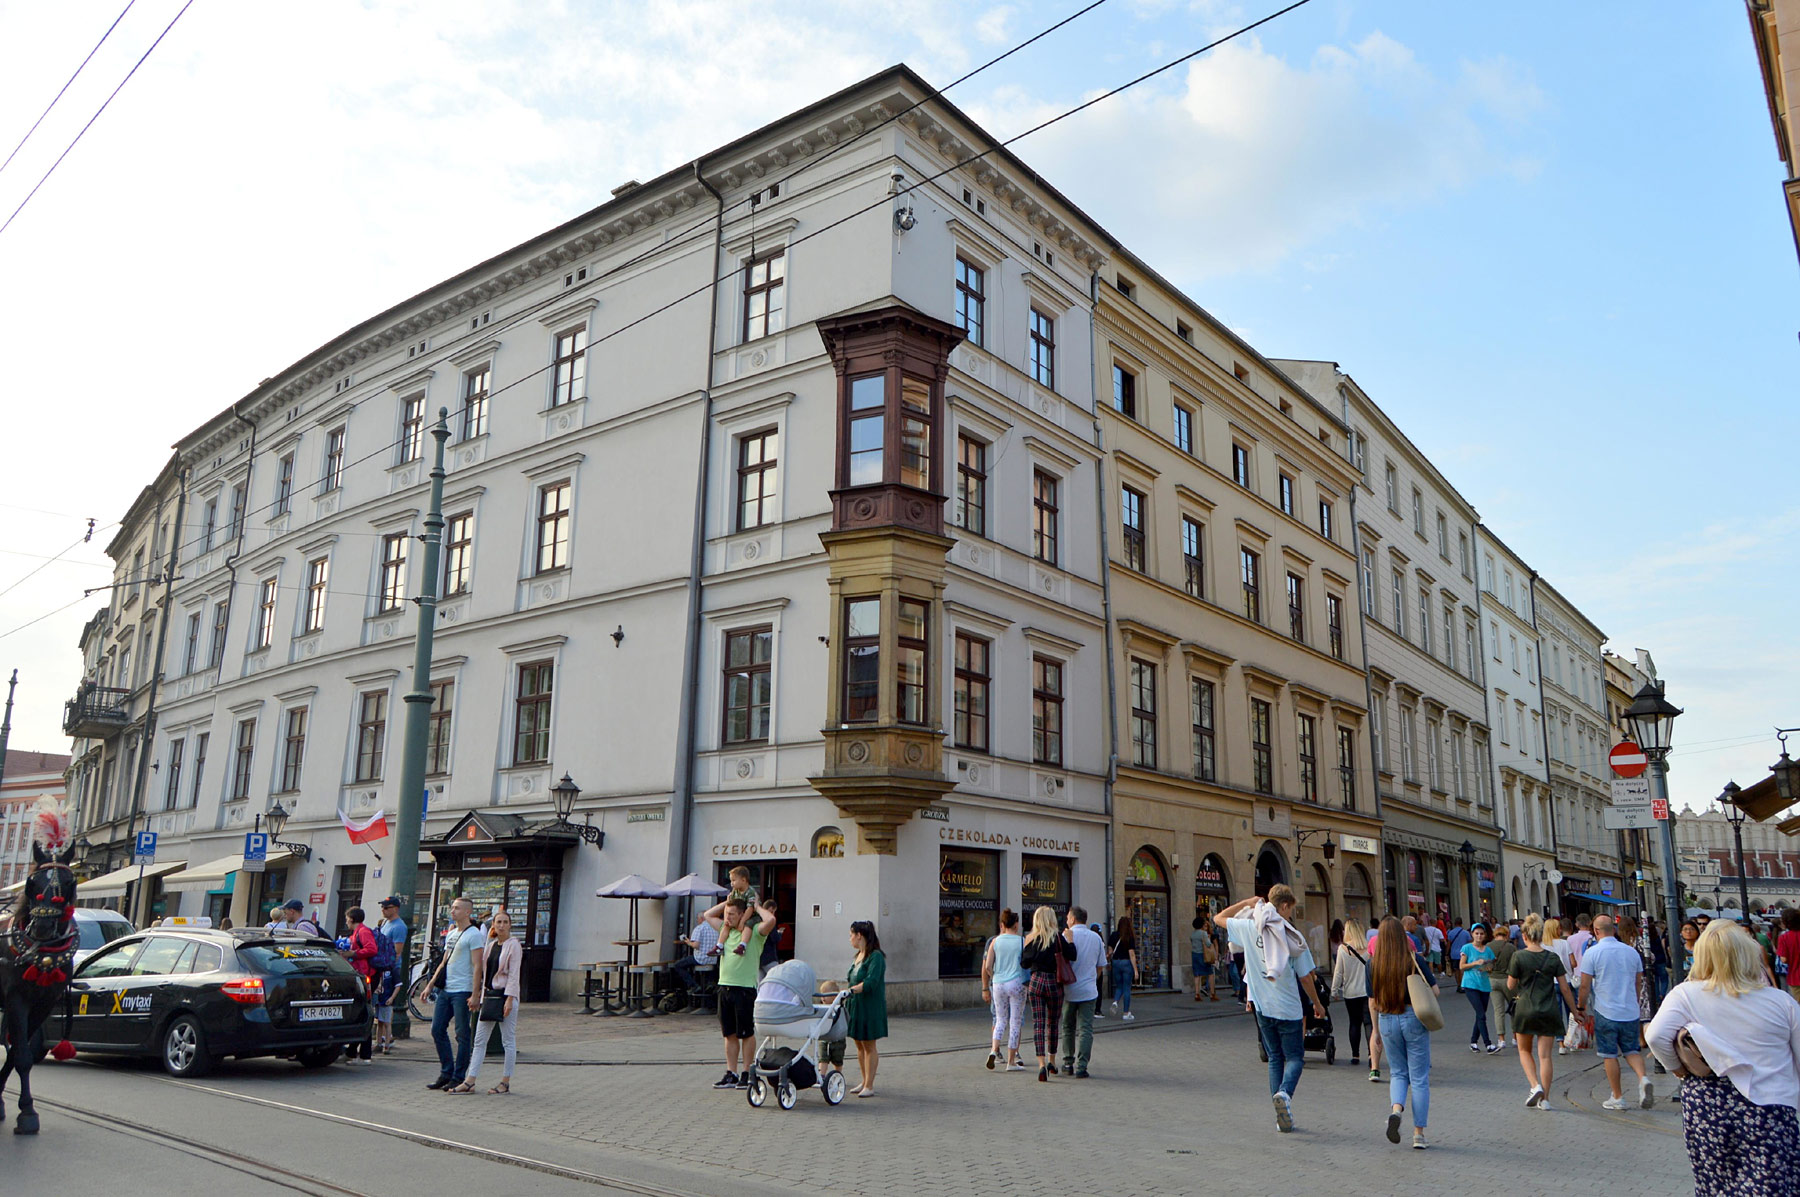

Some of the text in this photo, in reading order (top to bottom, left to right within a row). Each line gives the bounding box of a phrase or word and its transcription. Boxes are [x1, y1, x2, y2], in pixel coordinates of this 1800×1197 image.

[922, 810, 949, 821] GRODZKA
[140, 833, 154, 849] P
[249, 834, 264, 852] P
[939, 827, 1080, 853] CZEKOLADA CHOCOLATE
[712, 843, 799, 855] CZEKOLADA
[941, 872, 982, 886] KARMELLO
[964, 900, 993, 910] CHOCOLATE
[291, 948, 327, 957] mytaxi
[122, 993, 152, 1012] mytaxi
[304, 1007, 341, 1019] KR 4V827
